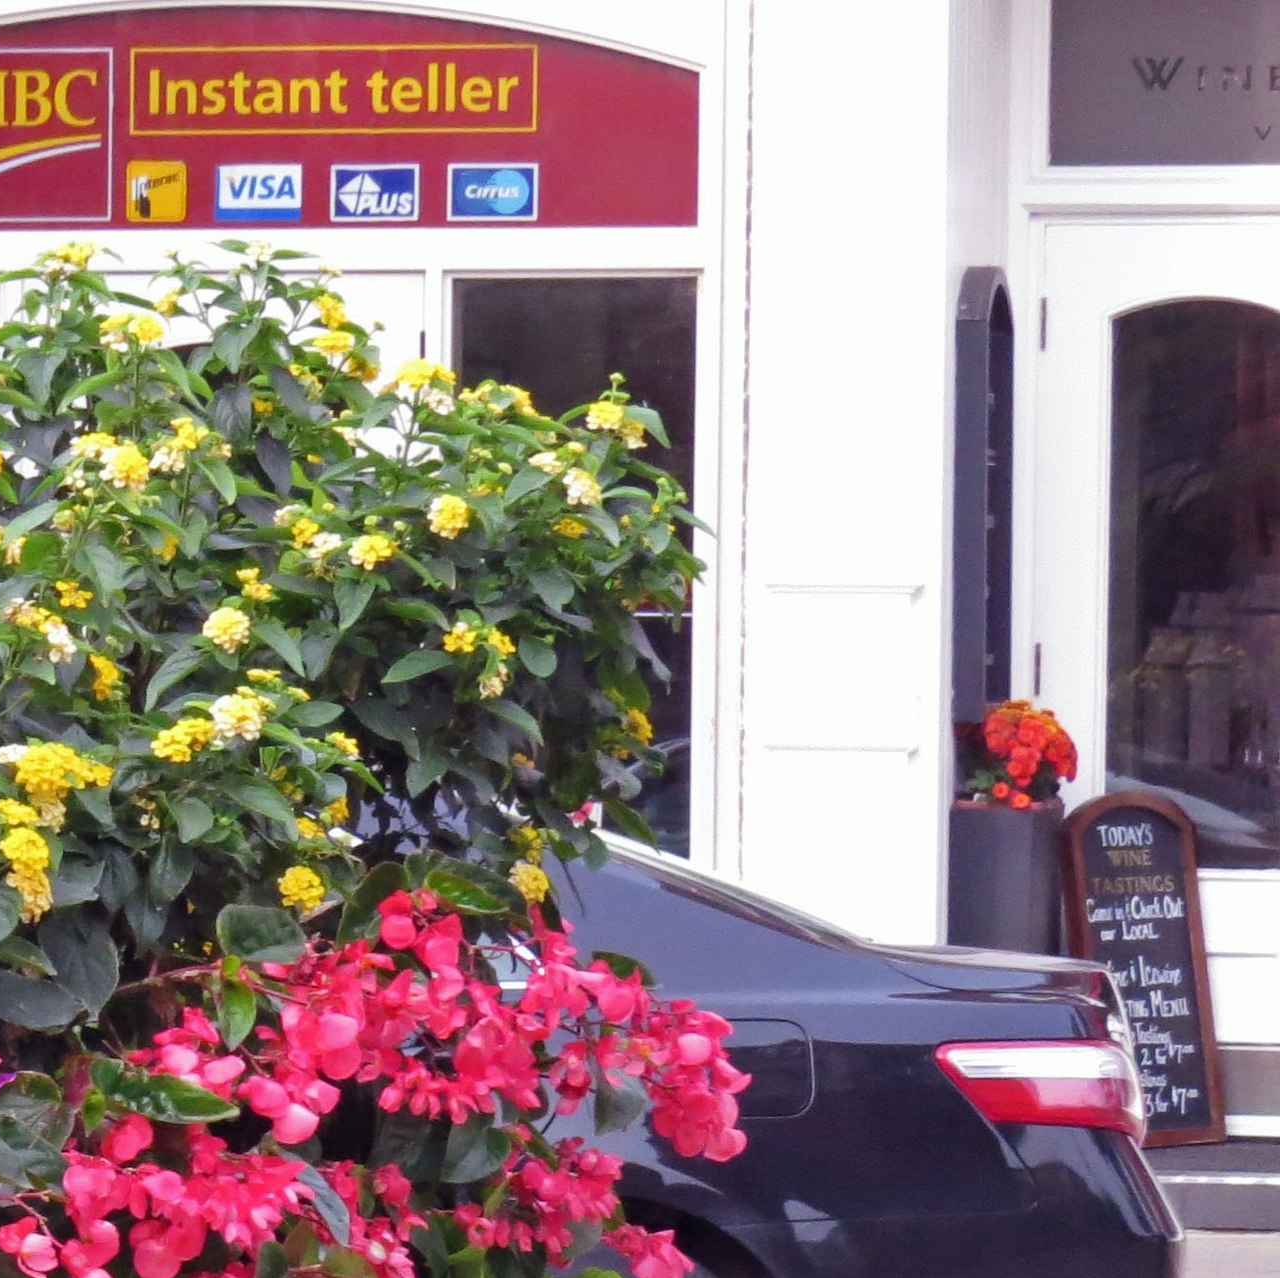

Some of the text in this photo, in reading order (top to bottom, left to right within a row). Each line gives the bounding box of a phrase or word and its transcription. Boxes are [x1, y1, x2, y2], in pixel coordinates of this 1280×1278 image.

[148, 62, 519, 115] Instant teller
[227, 174, 297, 199] VISA
[464, 182, 521, 199] Cirrus
[355, 191, 414, 216] PLUS
[1106, 849, 1152, 867] WINE
[1092, 876, 1175, 894] TASTINGS
[1141, 1048, 1152, 1067] 2
